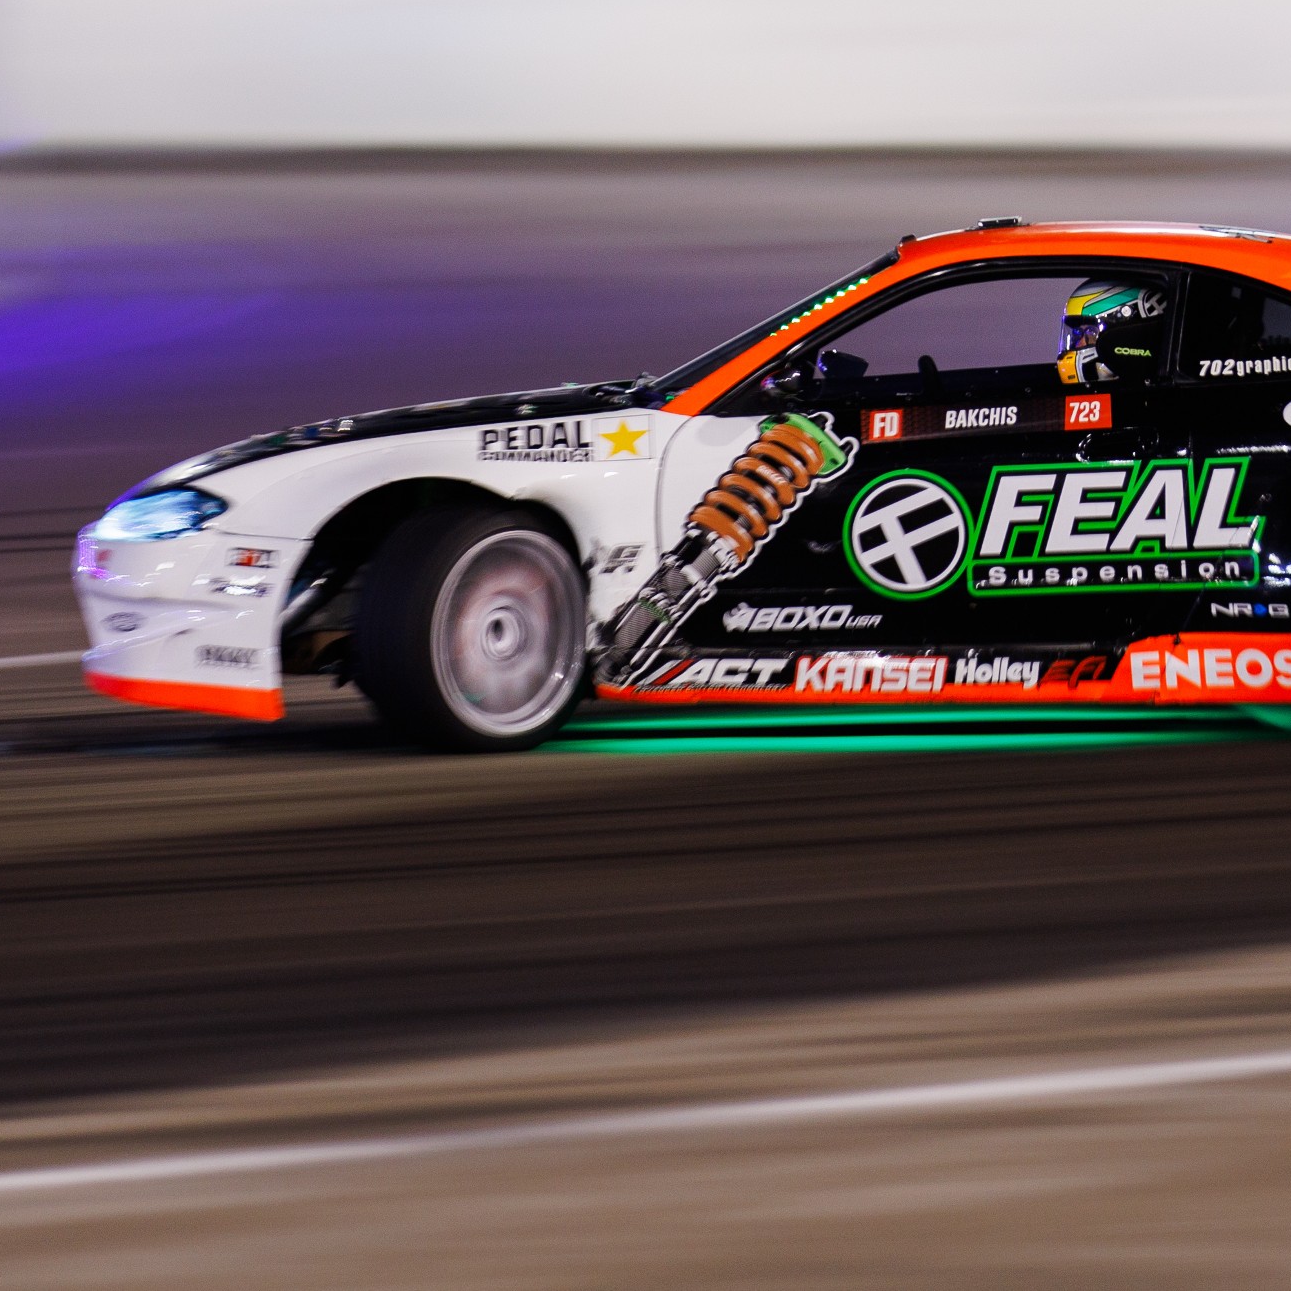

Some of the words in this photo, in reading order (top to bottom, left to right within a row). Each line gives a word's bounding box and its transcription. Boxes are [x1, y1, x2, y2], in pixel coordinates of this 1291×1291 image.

[1114, 347, 1152, 357] COBRA
[873, 412, 899, 438] FD
[945, 406, 1018, 429] BAKCHIS
[1069, 401, 1101, 423] 723
[480, 420, 593, 451] PEDAL
[979, 468, 1260, 557] FEAL
[987, 560, 1241, 585] Suspension
[748, 604, 854, 633] BOXO
[845, 614, 884, 630] USA
[667, 657, 793, 686] ACT
[795, 657, 947, 693] KANSEI
[953, 656, 1042, 691] Holley
